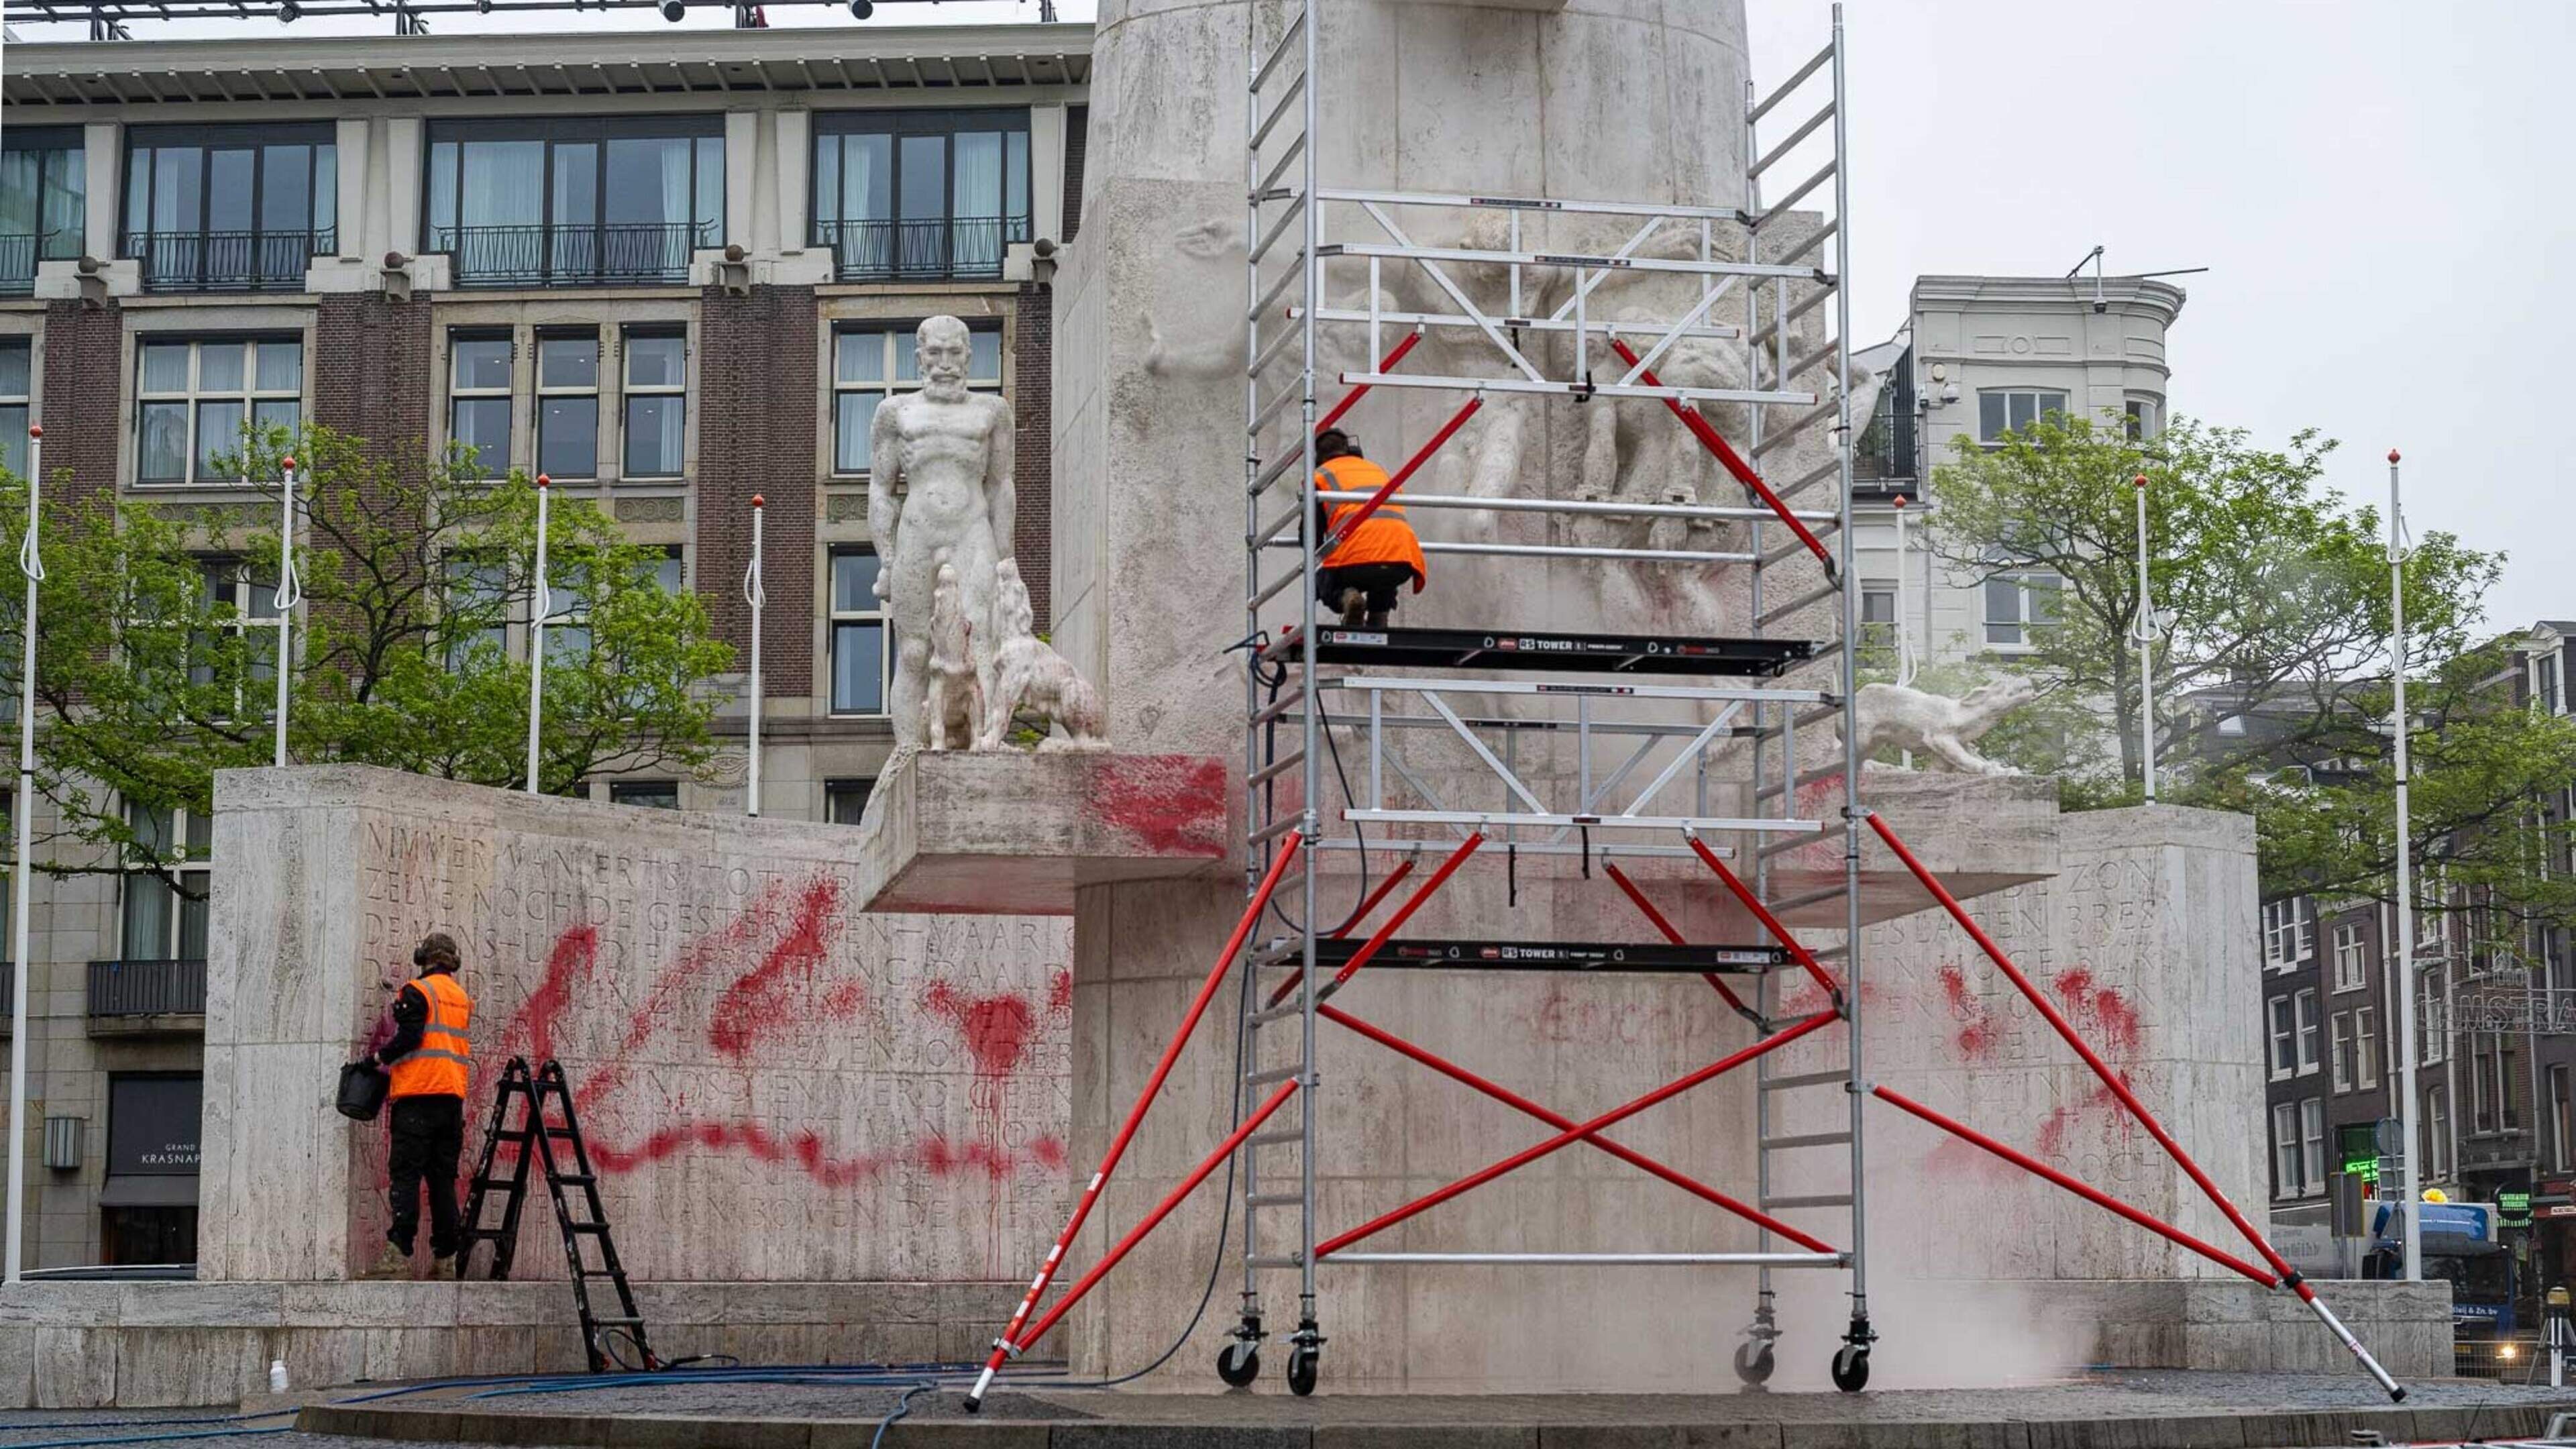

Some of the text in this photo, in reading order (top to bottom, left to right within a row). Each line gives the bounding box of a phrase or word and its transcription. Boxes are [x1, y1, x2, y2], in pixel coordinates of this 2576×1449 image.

[1537, 641, 1572, 650] TOWER
[595, 853, 680, 890] ERTS
[700, 864, 780, 899] TOT
[474, 884, 570, 922] NOCH
[591, 896, 630, 928] DE
[2065, 900, 2156, 937] BRES
[1520, 949, 1555, 959] TOWER
[166, 1144, 196, 1152] GRAND
